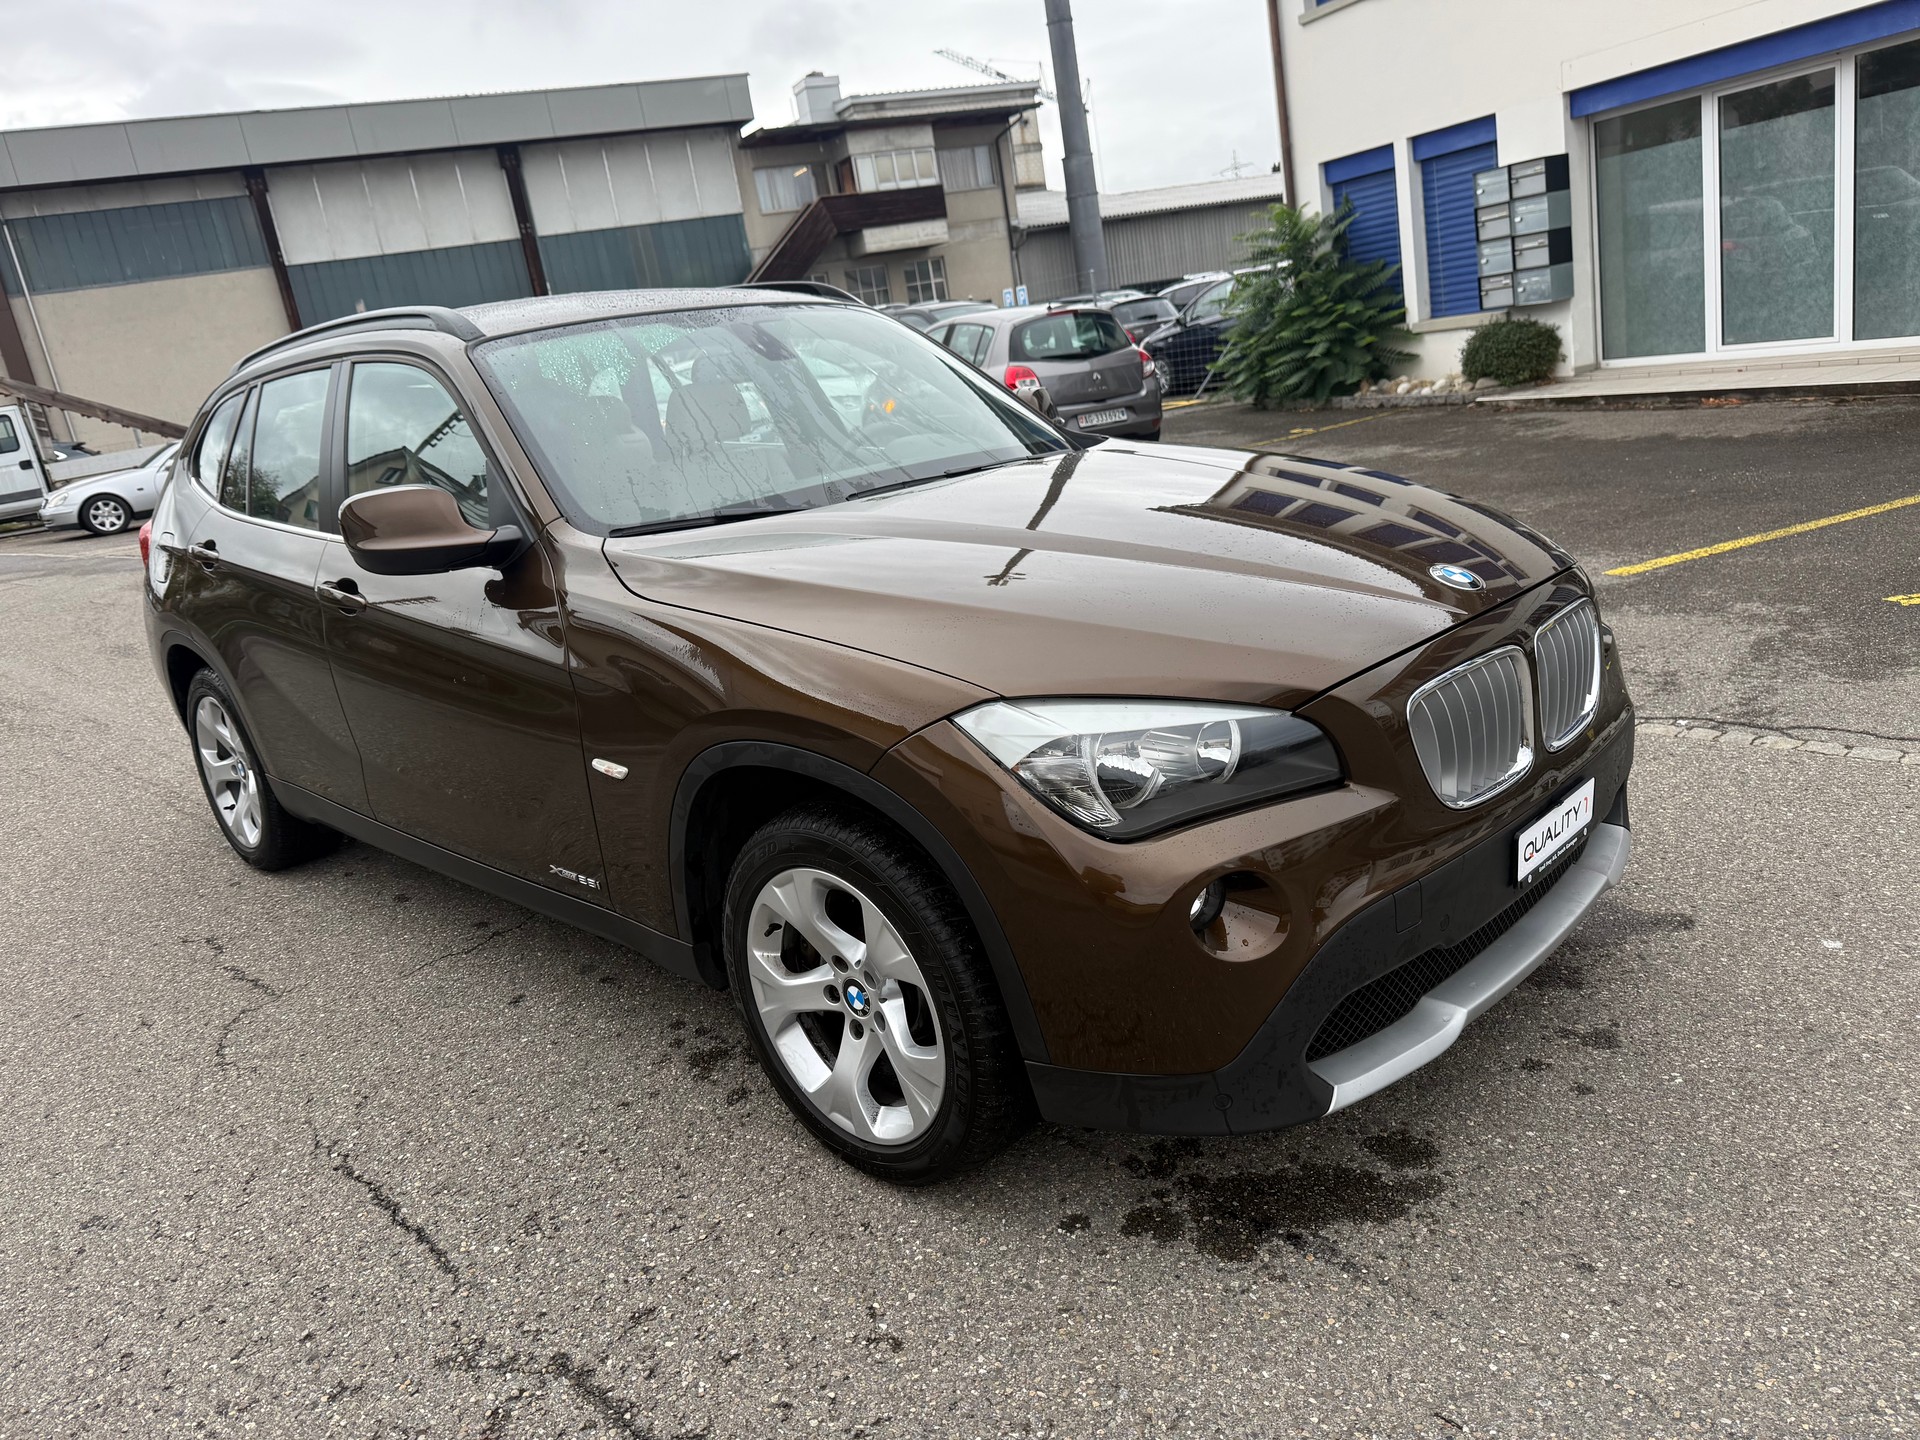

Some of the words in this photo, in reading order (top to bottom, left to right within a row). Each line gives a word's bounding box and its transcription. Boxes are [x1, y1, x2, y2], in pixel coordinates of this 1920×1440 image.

[1524, 800, 1582, 862] QUALITY
[1583, 796, 1588, 813] 1
[931, 969, 970, 1121] DUNLOP
